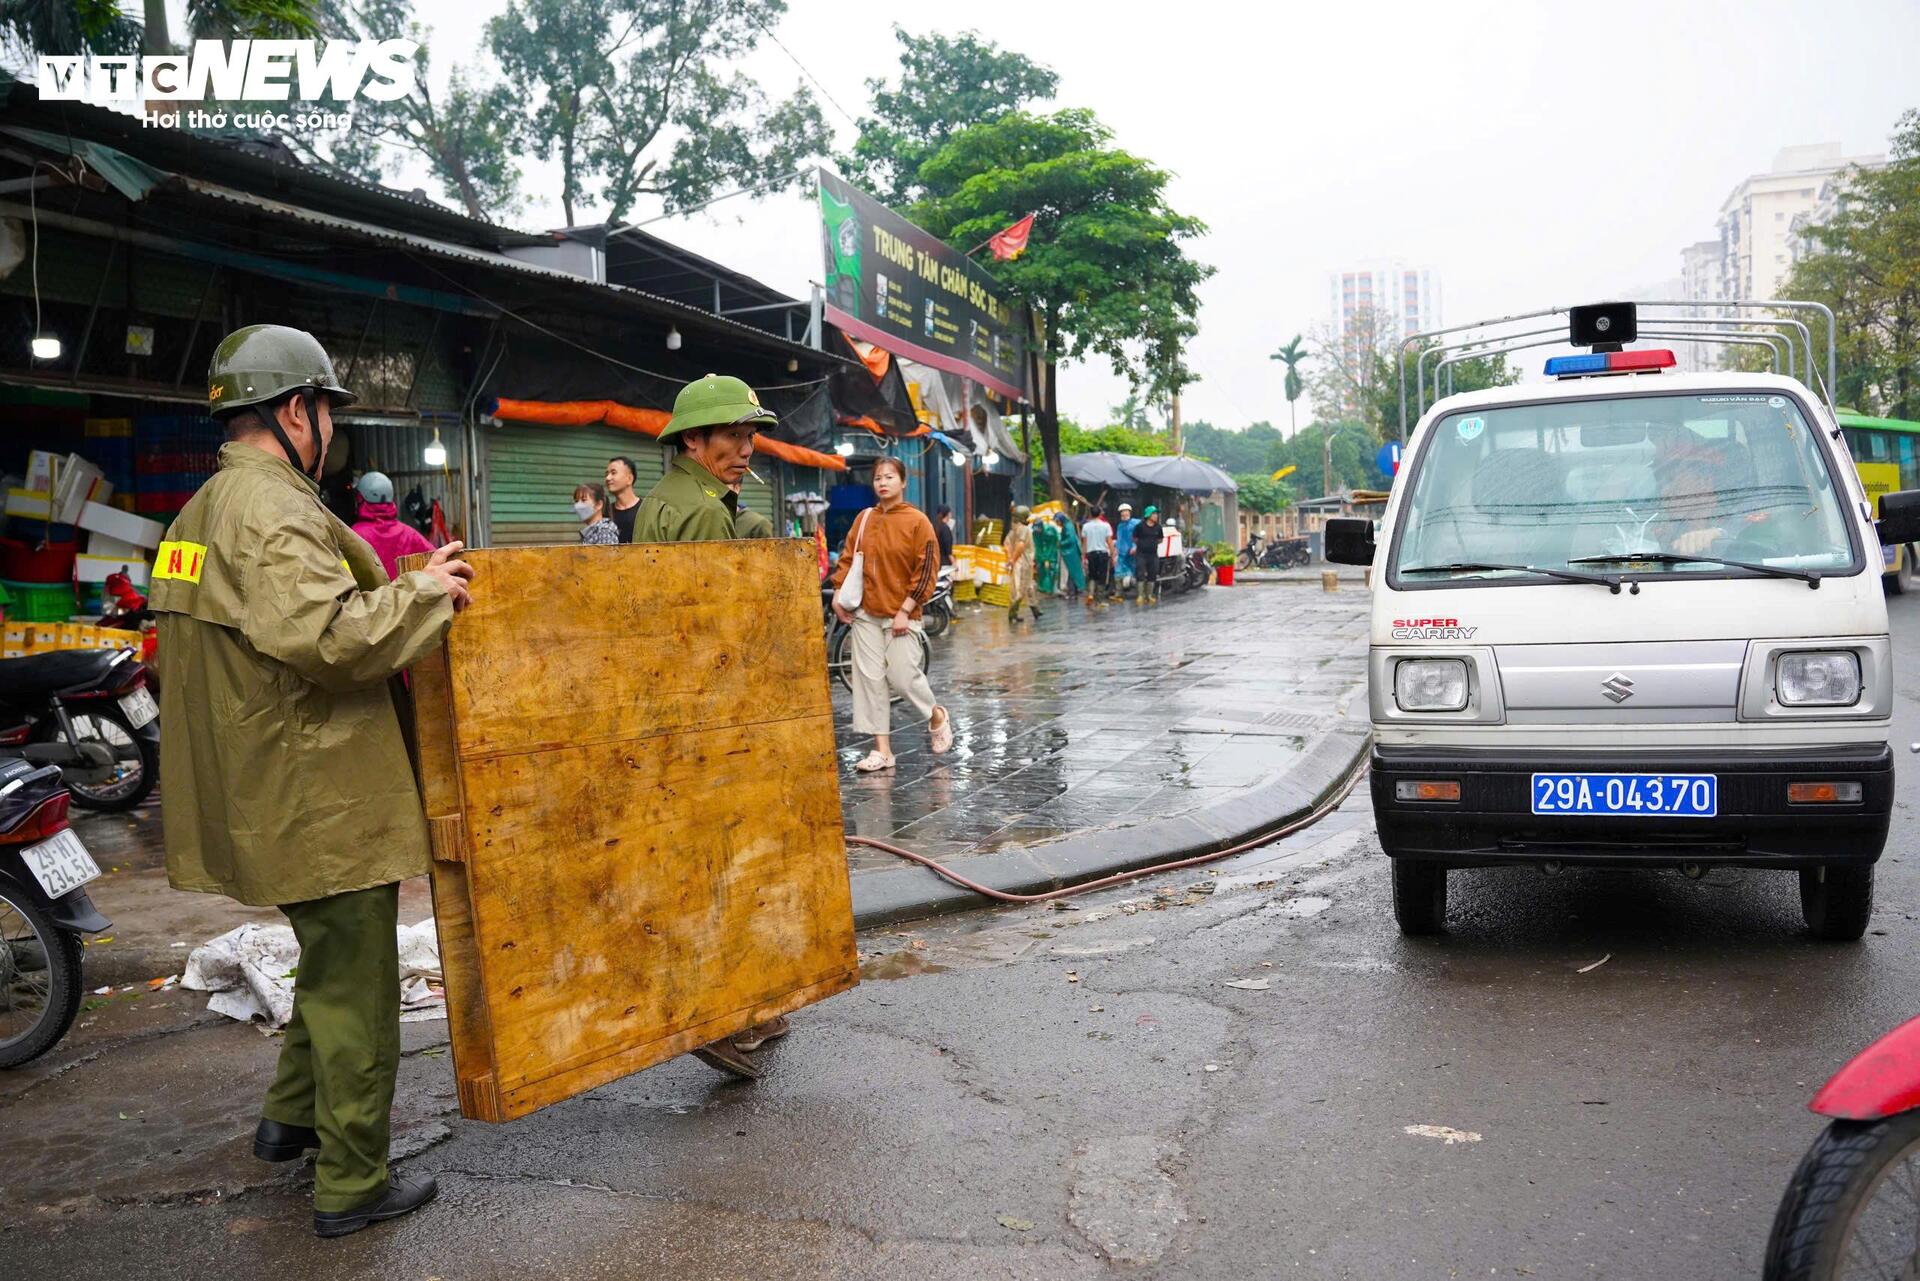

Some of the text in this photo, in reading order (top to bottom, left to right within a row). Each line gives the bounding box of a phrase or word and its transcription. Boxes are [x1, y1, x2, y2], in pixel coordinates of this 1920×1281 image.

[873, 224, 914, 271] TRUNG
[1392, 618, 1458, 628] SUPER
[1392, 626, 1478, 640] CARRY
[1537, 777, 1710, 812] 29A-043.70
[42, 855, 95, 895] 234.54
